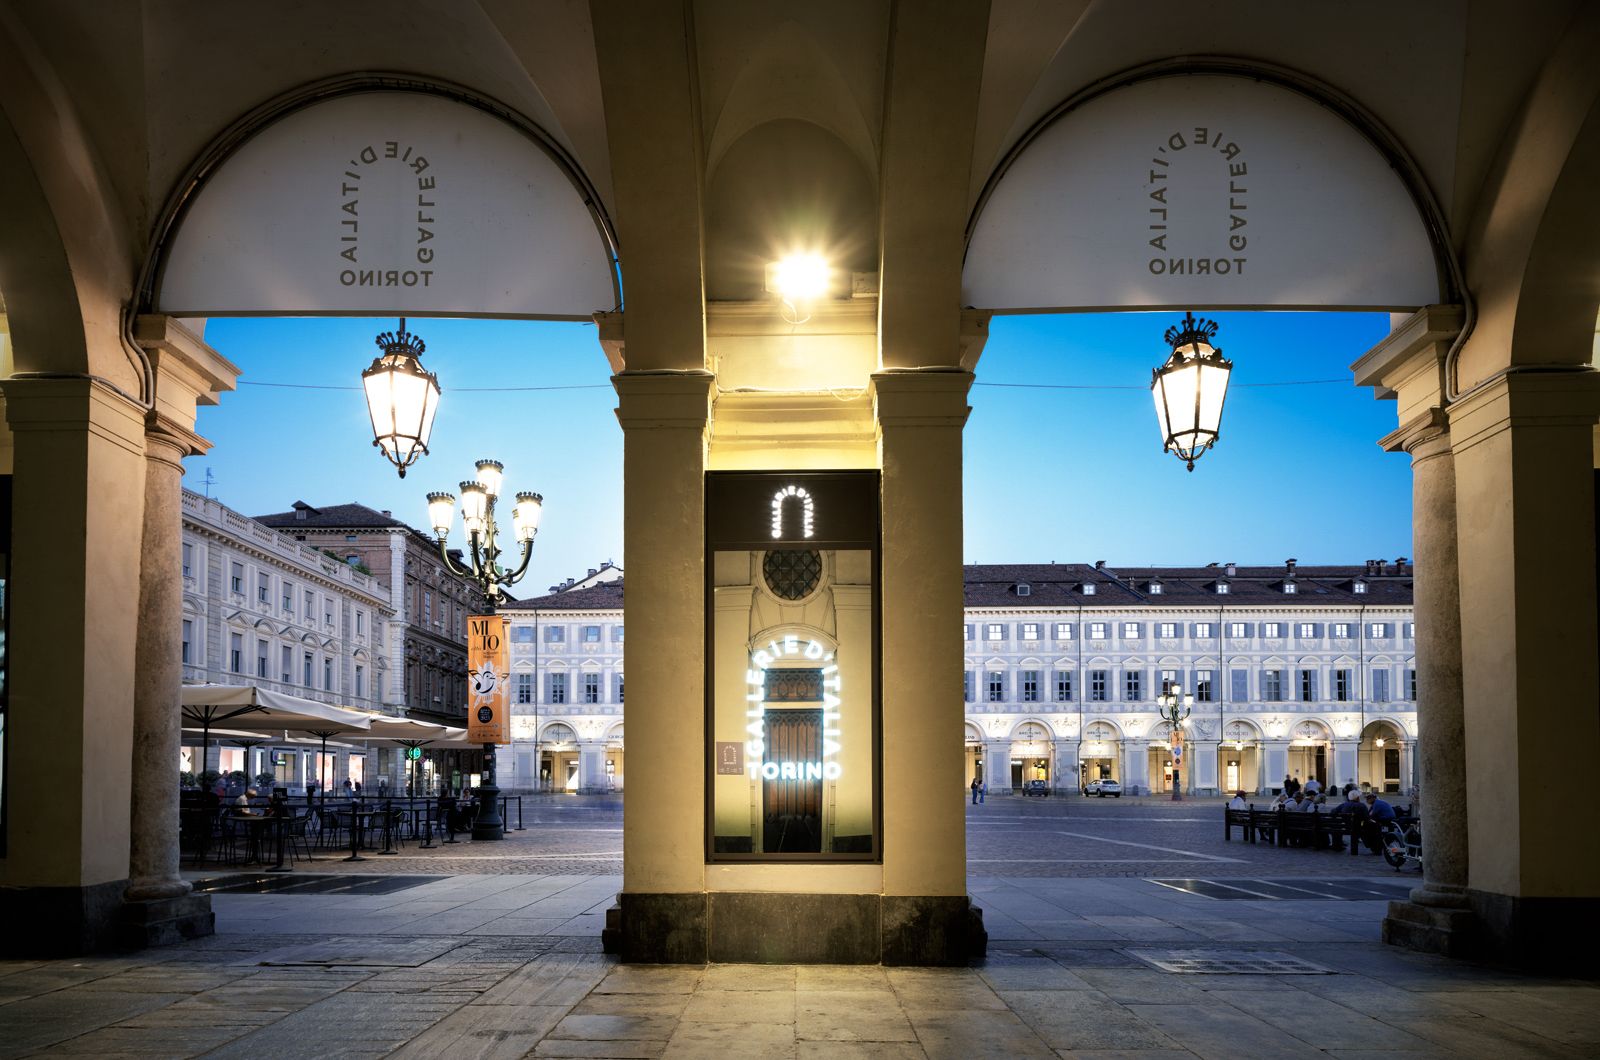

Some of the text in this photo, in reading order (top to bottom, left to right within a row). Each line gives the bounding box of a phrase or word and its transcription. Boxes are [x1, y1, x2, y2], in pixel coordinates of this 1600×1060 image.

[471, 620, 488, 636] MI
[480, 634, 499, 650] TO
[746, 635, 841, 757] GALLERIE D'ITALIA
[746, 762, 841, 780] TORINO
